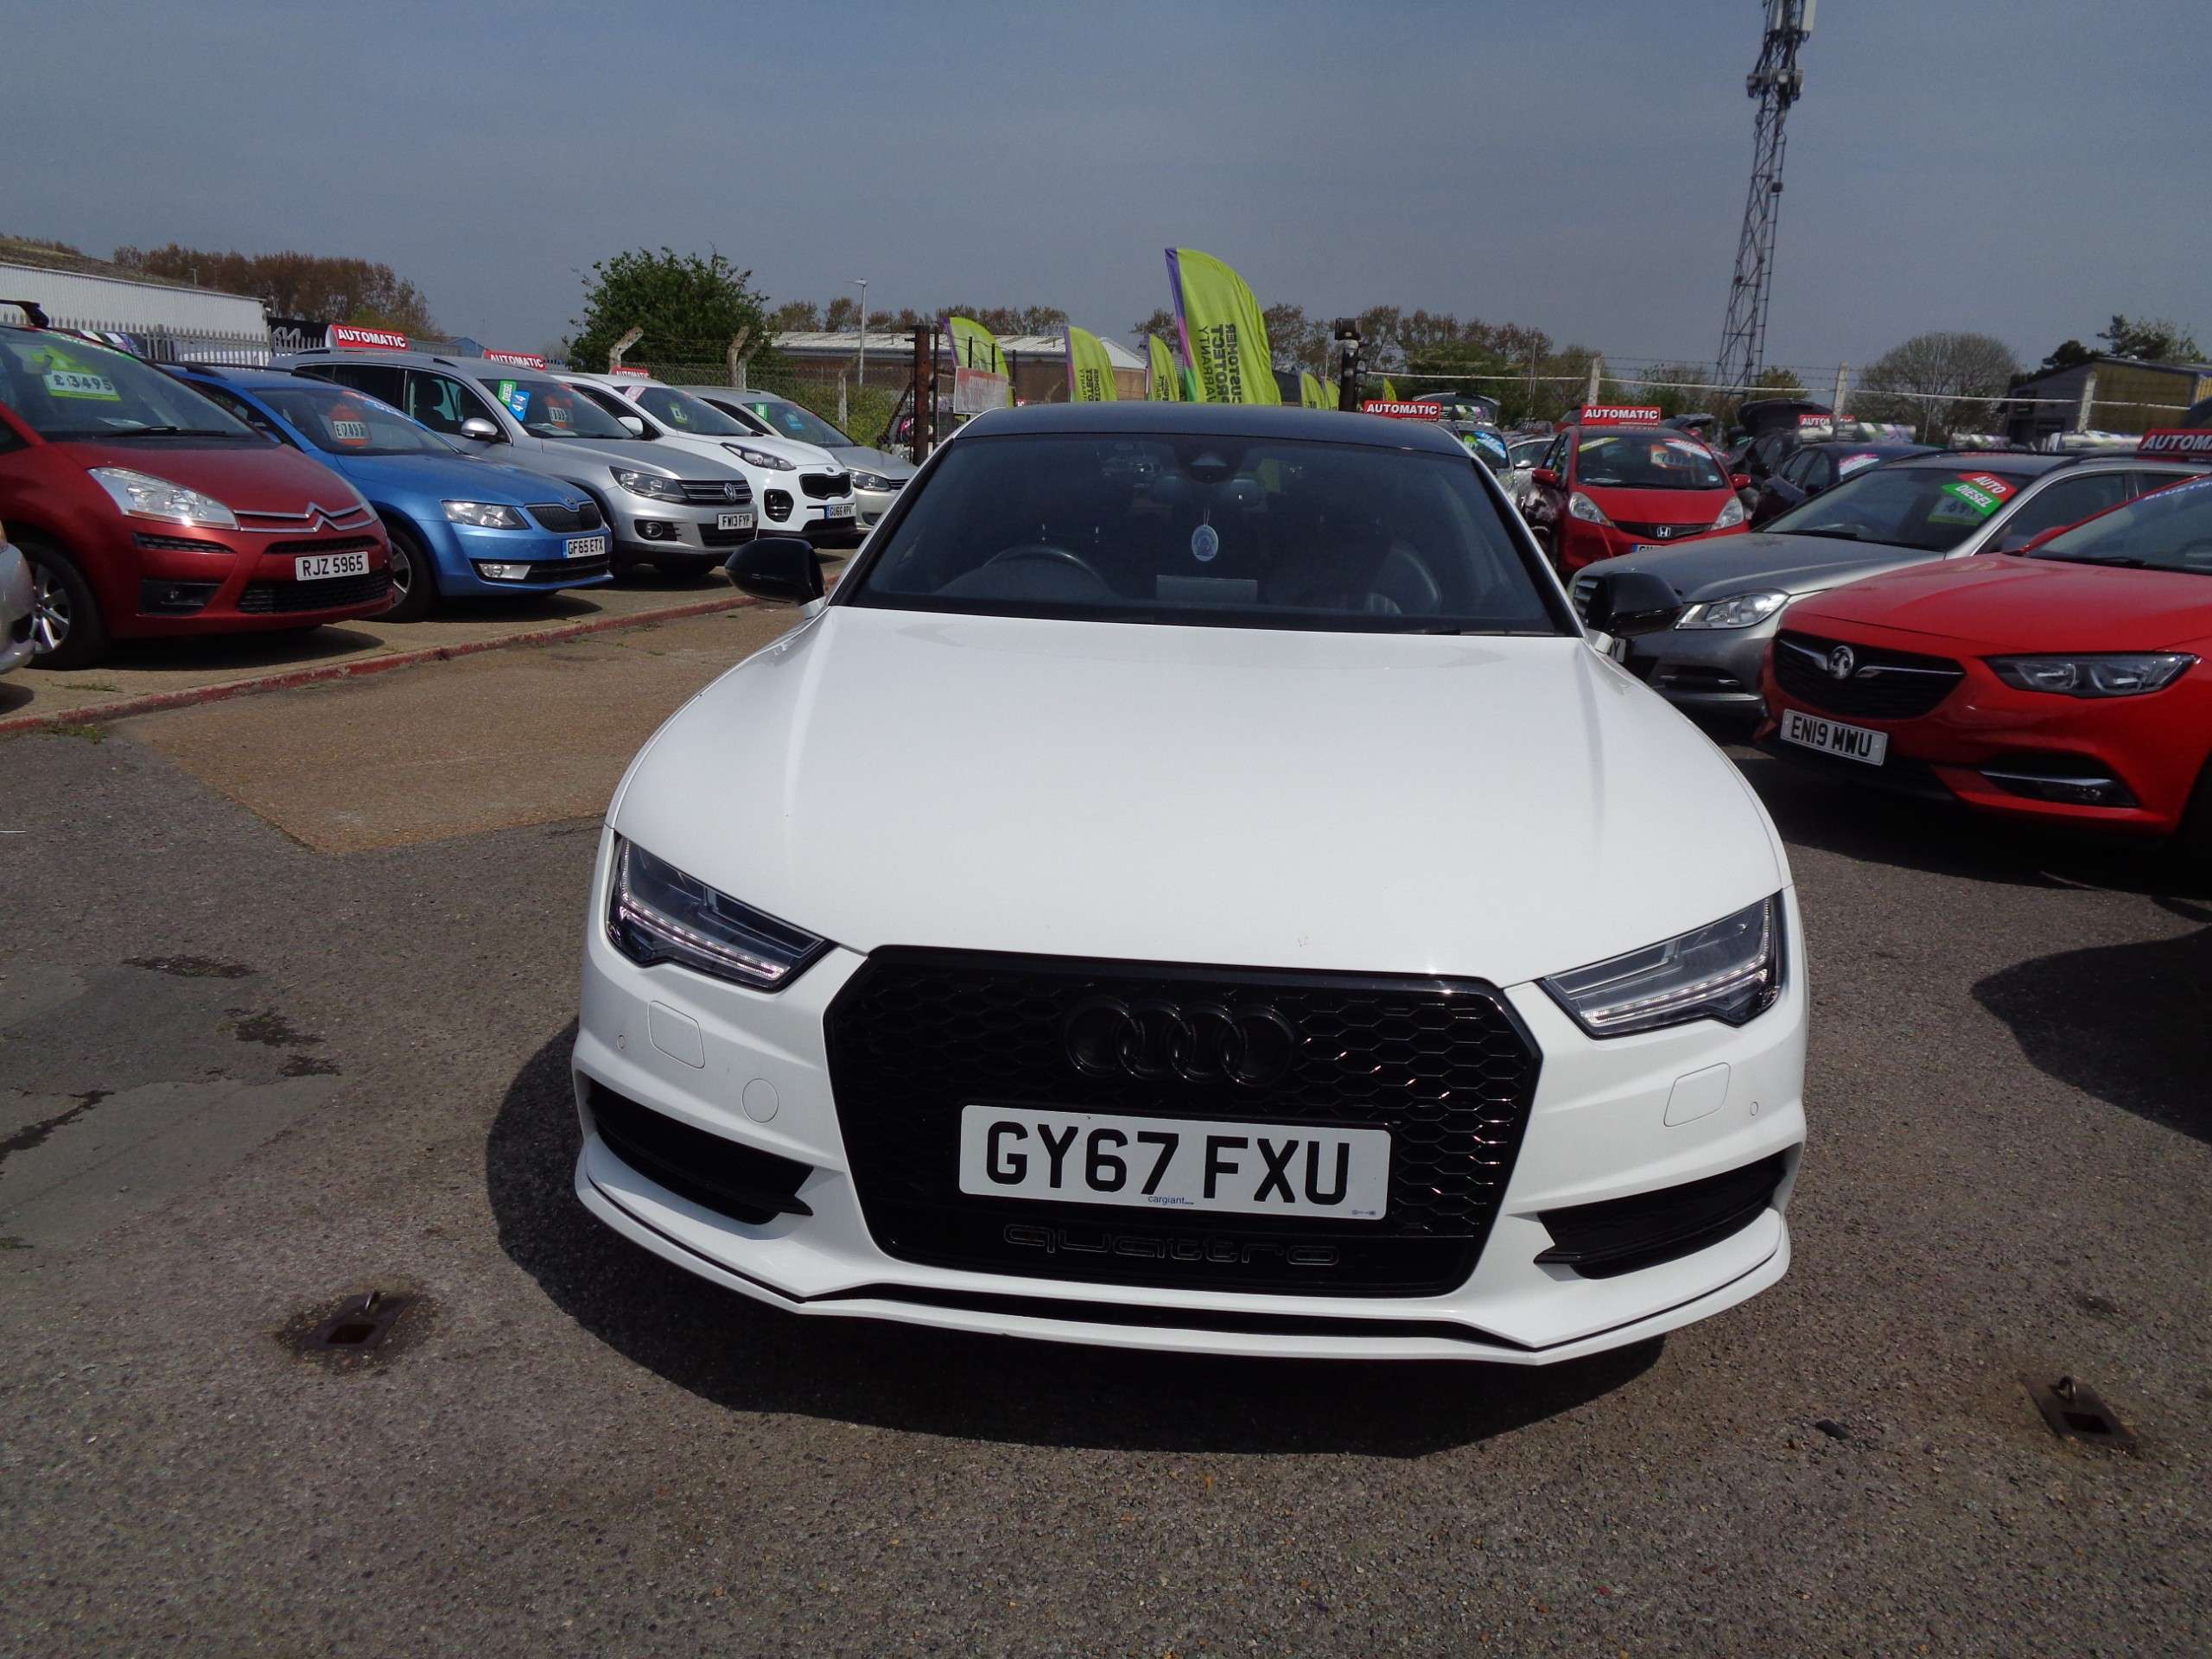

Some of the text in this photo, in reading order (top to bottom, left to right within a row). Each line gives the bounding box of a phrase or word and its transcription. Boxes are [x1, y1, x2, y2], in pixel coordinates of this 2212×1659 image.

[338, 328, 406, 347] AUTOMATIC
[490, 353, 544, 368] AUTOMATIC
[1366, 404, 1438, 416] AUTOMATIC
[1584, 409, 1658, 420] AUTOMATIC
[1973, 476, 2006, 494] AUTO
[1955, 485, 1993, 508] DIESEL
[739, 514, 750, 526] FYP
[568, 537, 603, 555] GF65 ETX
[302, 555, 364, 577] RJZ 5965
[1789, 715, 1873, 758] EN19 MWU
[986, 1121, 1351, 1206] GY67 FXU
[1147, 1194, 1185, 1205] cargiant
[1002, 1223, 1340, 1267] quattro
